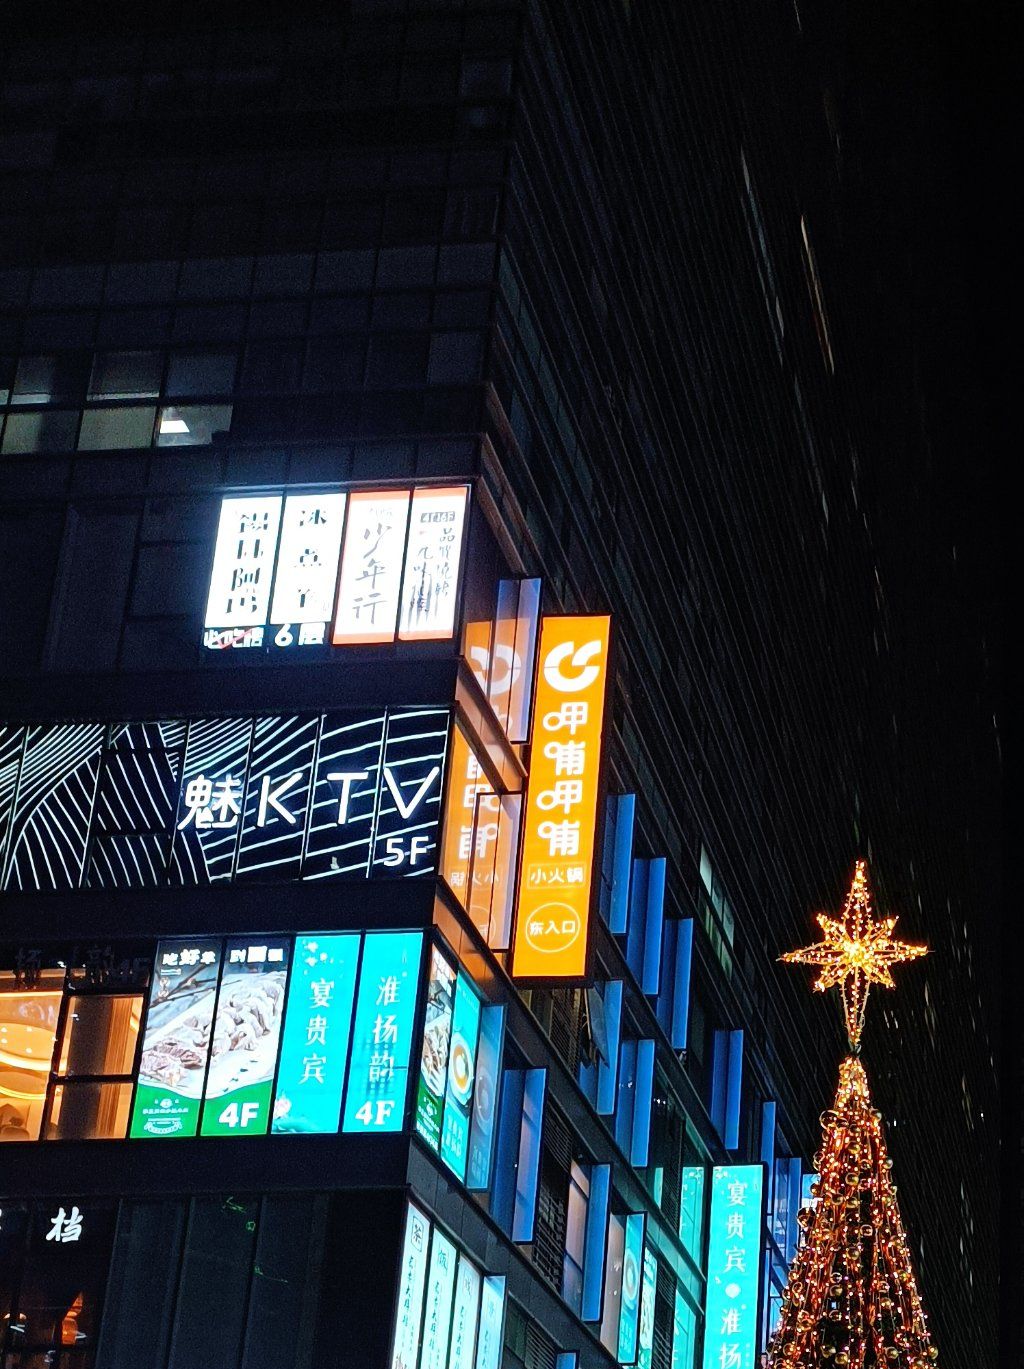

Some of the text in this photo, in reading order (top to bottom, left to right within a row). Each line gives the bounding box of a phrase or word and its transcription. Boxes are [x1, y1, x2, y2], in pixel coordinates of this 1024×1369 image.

[177, 766, 440, 830] 魅 KTV
[536, 701, 588, 856] 呷哺呷哺
[383, 837, 428, 866] 5F
[530, 868, 585, 884] 小火锅
[529, 920, 576, 935] 东入口
[299, 978, 335, 1084] 宴贵宾
[368, 975, 399, 1081] 淮扬韵
[218, 1102, 259, 1127] 4F
[355, 1100, 395, 1126] 4F
[723, 1180, 748, 1274] 宴贵宾
